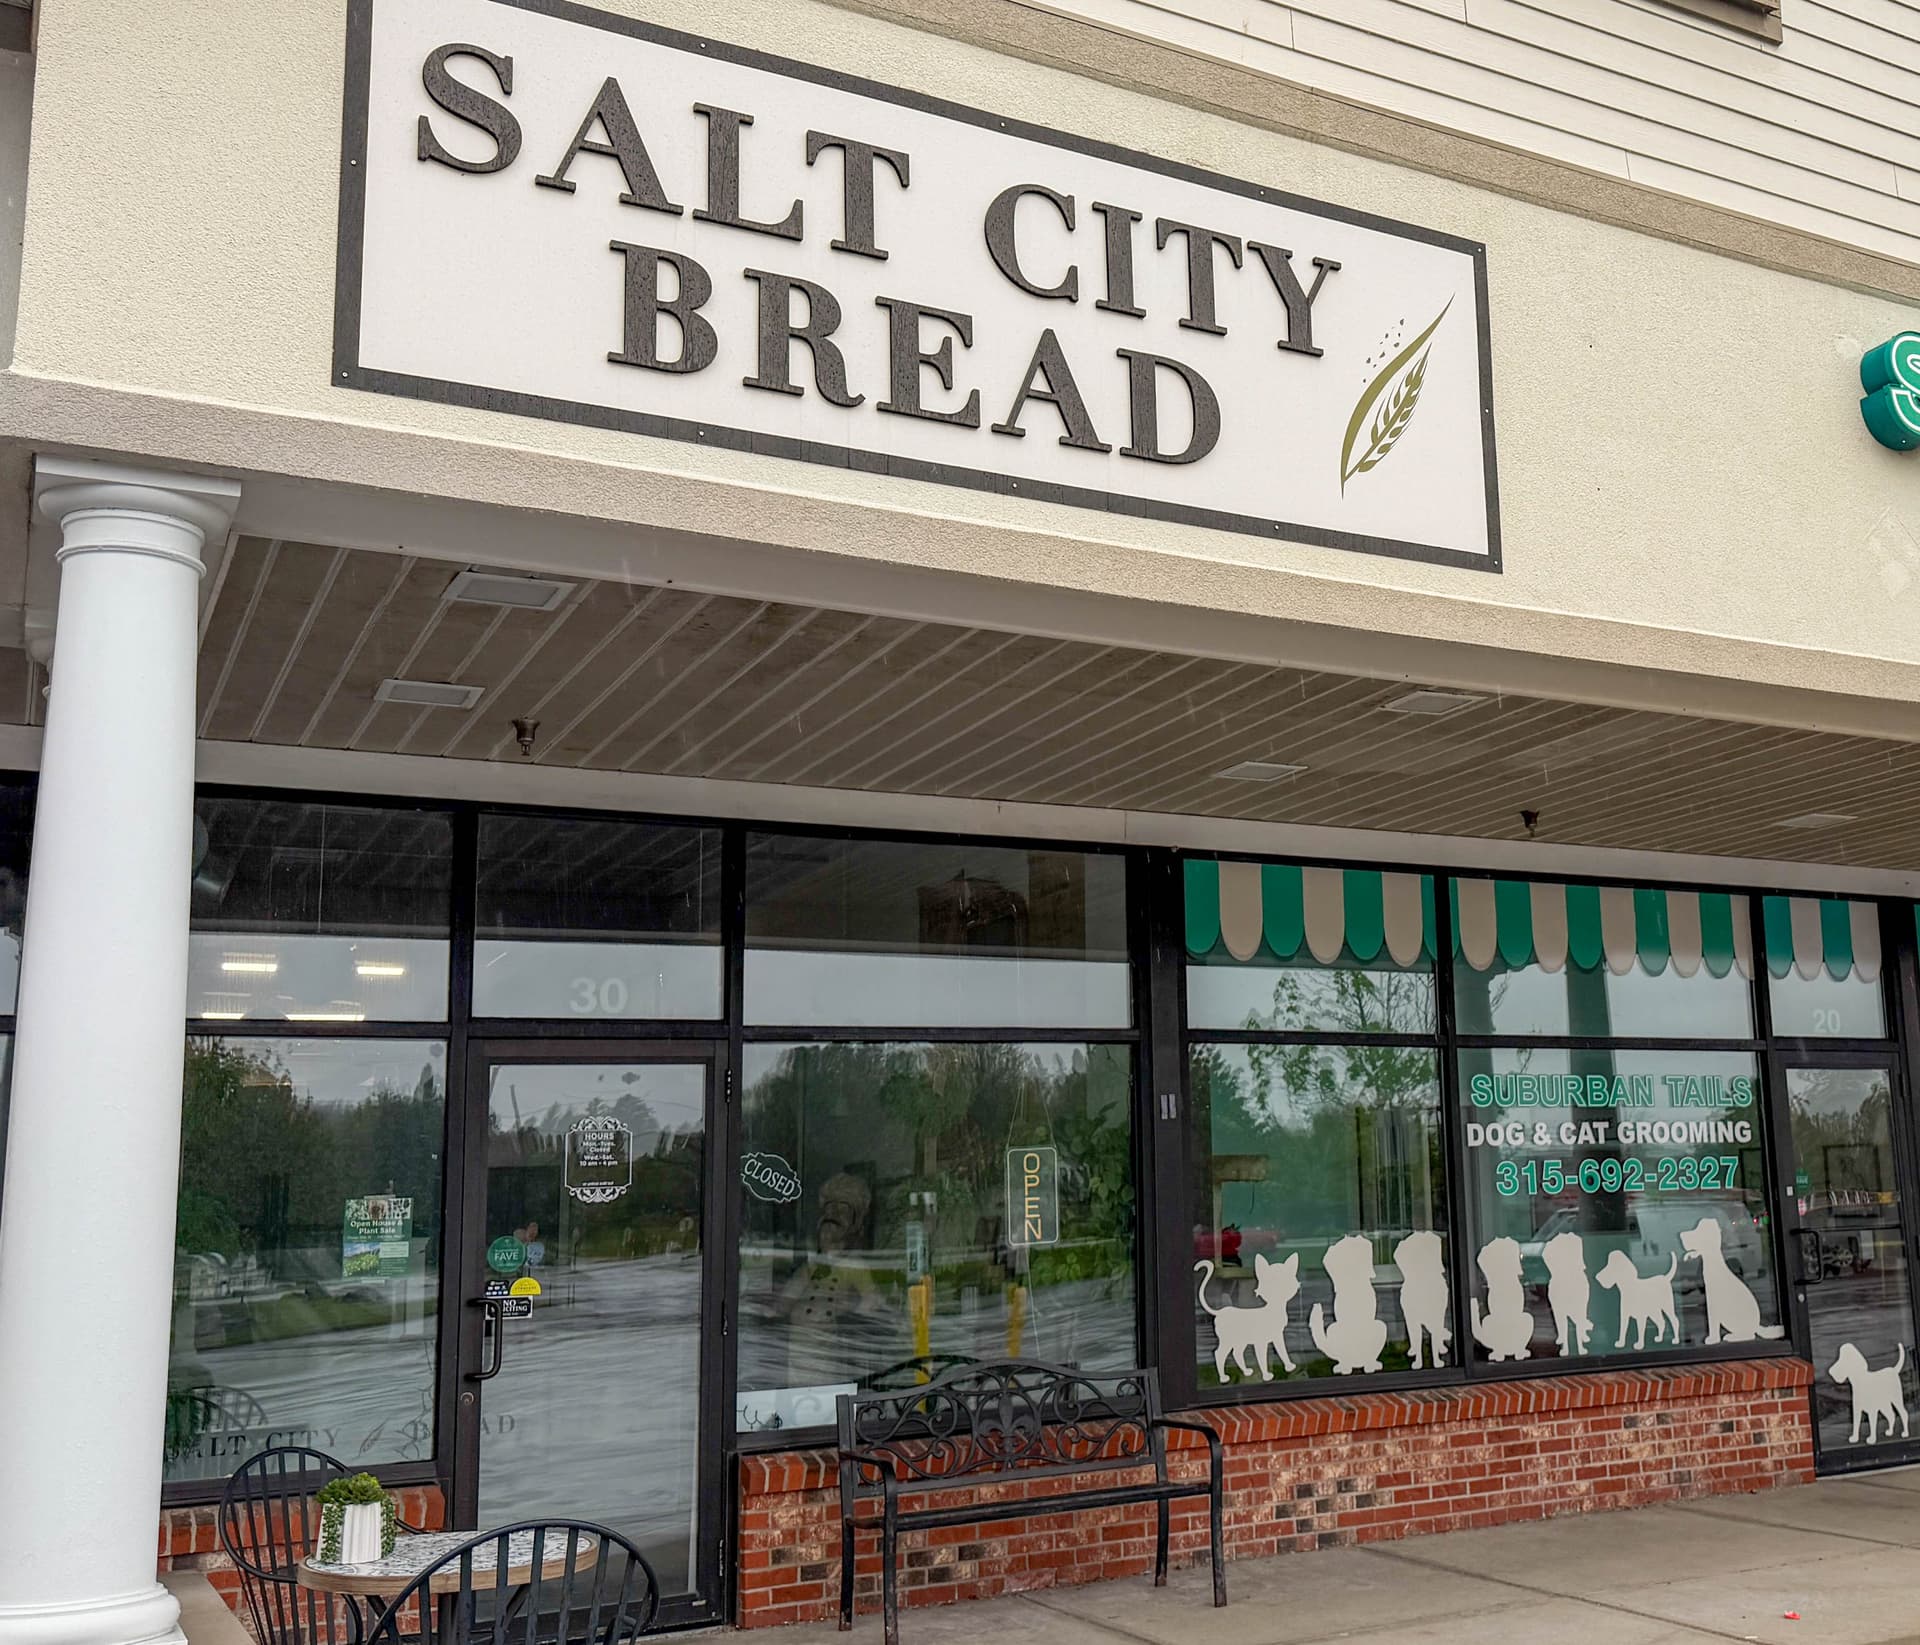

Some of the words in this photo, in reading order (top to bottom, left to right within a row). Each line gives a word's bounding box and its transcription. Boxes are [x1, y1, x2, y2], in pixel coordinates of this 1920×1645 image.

[417, 42, 911, 261] SALT
[983, 183, 1342, 358] CITY
[607, 239, 1222, 465] BREAD
[569, 976, 629, 1015] 30
[1812, 1008, 1841, 1034] 20
[1470, 1073, 1654, 1108] SUBURBAN
[1666, 1073, 1753, 1108] TAILS
[584, 1132, 615, 1141] HOURS
[1467, 1121, 1525, 1147] DOG
[1532, 1121, 1553, 1146] &
[1559, 1121, 1610, 1145] CAT
[1616, 1120, 1753, 1144] GROOMING
[743, 1158, 796, 1198] CLOSED
[1496, 1155, 1740, 1197] 315-692-2327
[1023, 1152, 1042, 1242] OPEN
[350, 1219, 371, 1229] Open
[372, 1219, 396, 1227] House
[358, 1227, 379, 1235] Plant
[380, 1226, 396, 1234] Sale
[494, 1251, 519, 1261] FAVE
[265, 1428, 344, 1451] CITY
